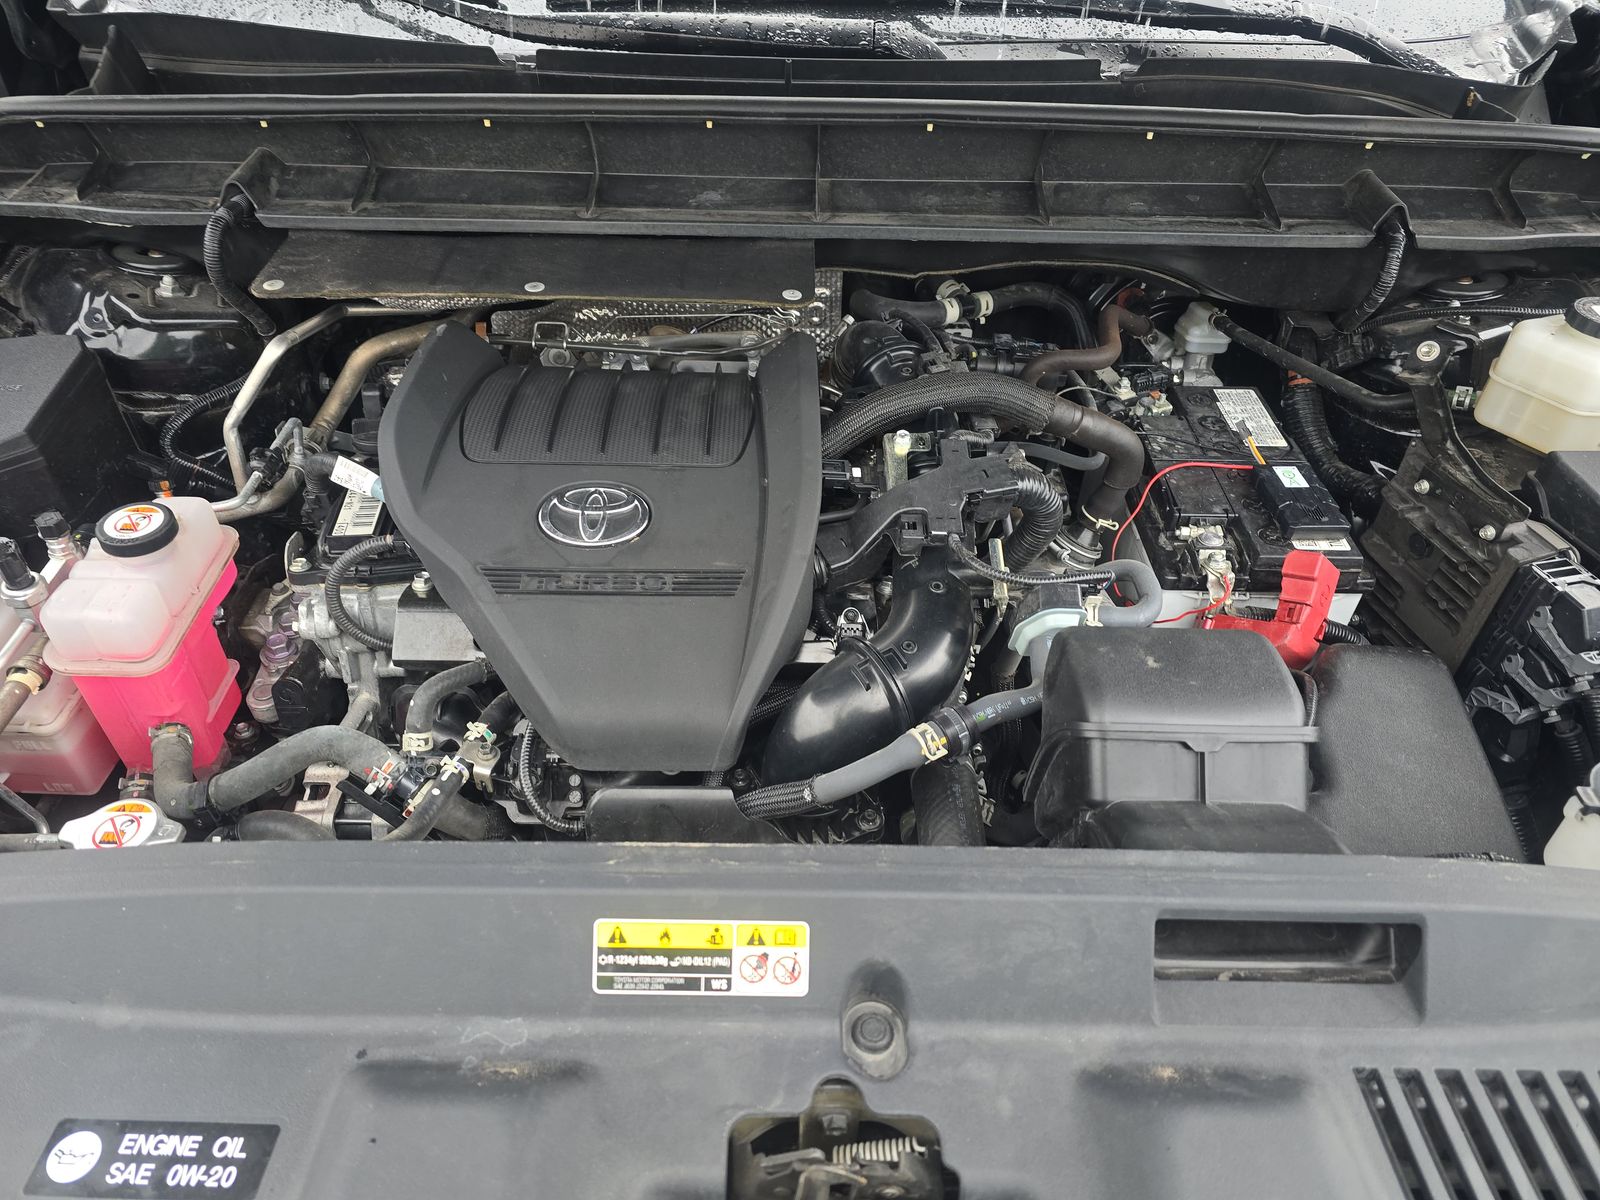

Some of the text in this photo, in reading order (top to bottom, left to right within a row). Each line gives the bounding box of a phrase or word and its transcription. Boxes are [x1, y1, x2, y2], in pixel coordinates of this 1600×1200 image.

[519, 573, 674, 592] TURBO
[710, 978, 728, 990] WS
[118, 1133, 247, 1159] ENGINE OIL
[105, 1162, 238, 1189] SAE 0W-20
